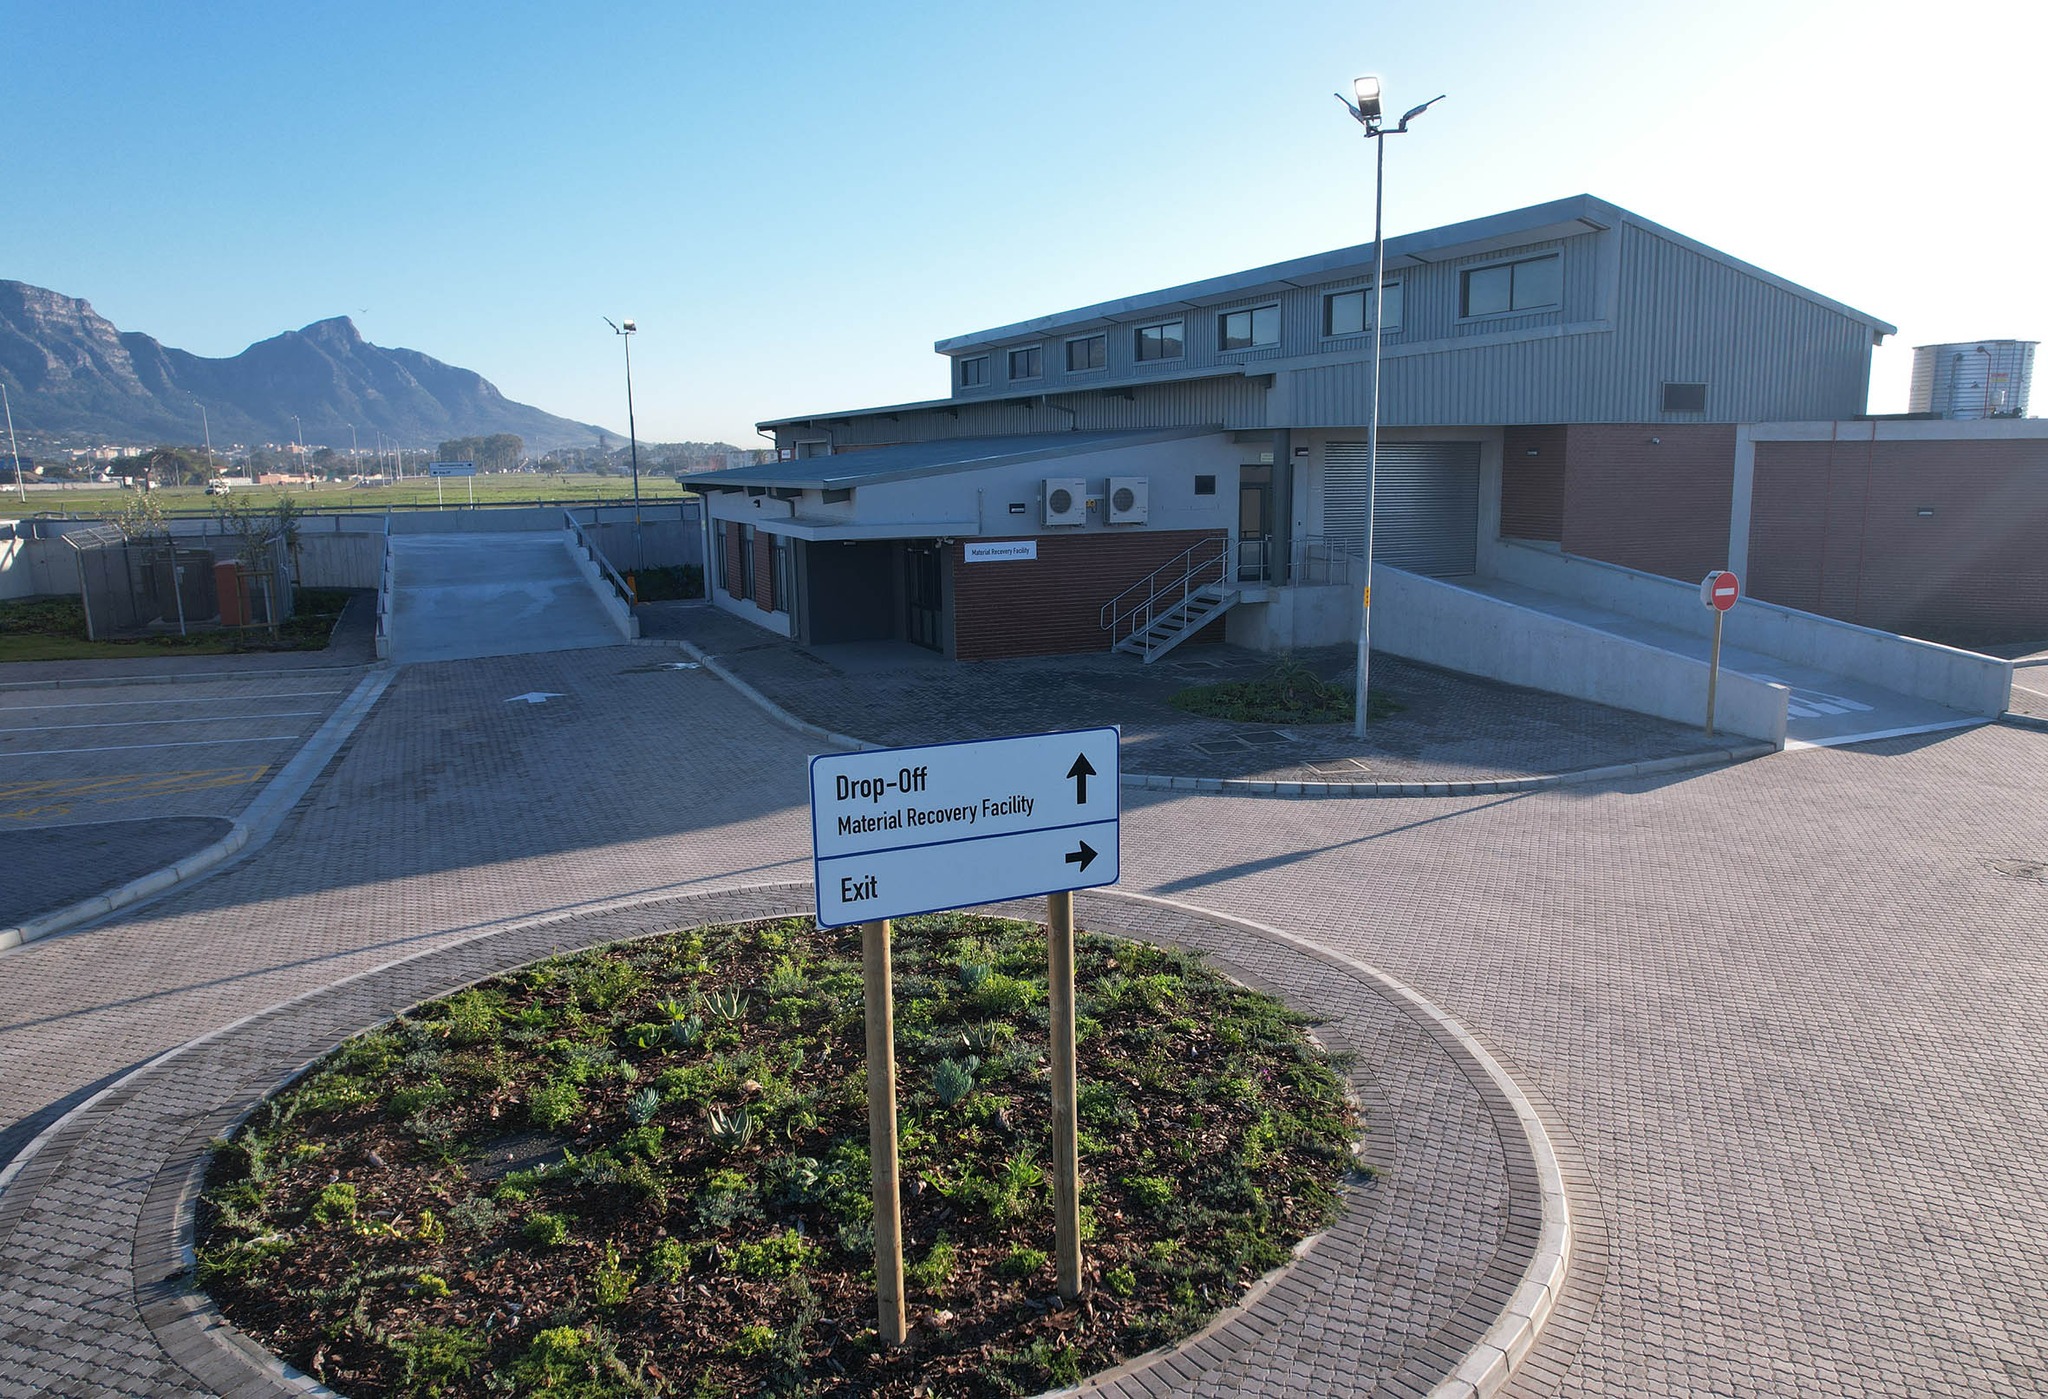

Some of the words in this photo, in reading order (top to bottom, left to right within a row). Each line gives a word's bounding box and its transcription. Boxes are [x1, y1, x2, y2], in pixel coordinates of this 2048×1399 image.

[1013, 547, 1029, 555] Facility
[836, 766, 928, 803] Drop-Off
[838, 809, 903, 835] Material
[907, 804, 978, 827] Recovery
[982, 795, 1035, 817] Facility
[841, 875, 878, 903] Exit
